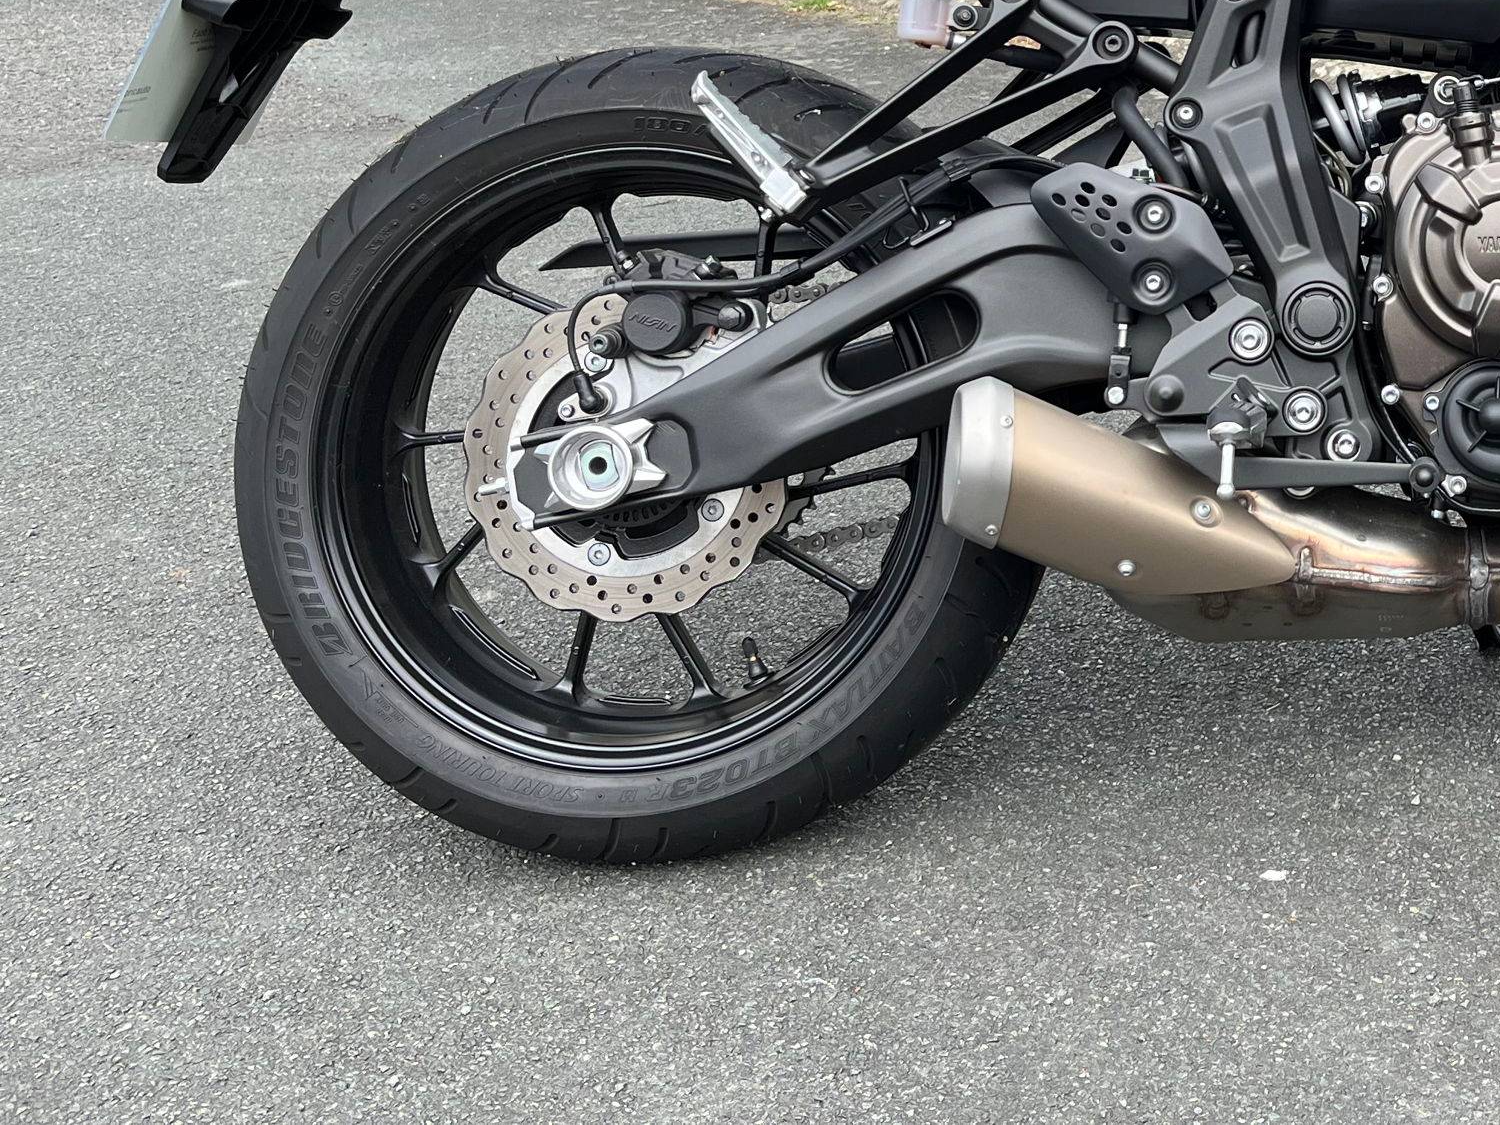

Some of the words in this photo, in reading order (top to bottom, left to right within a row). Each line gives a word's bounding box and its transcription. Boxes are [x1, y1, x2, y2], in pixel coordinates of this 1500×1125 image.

[274, 322, 353, 658] BRIDGESTONE
[415, 733, 507, 786] TOURING
[506, 775, 585, 803] SPORT
